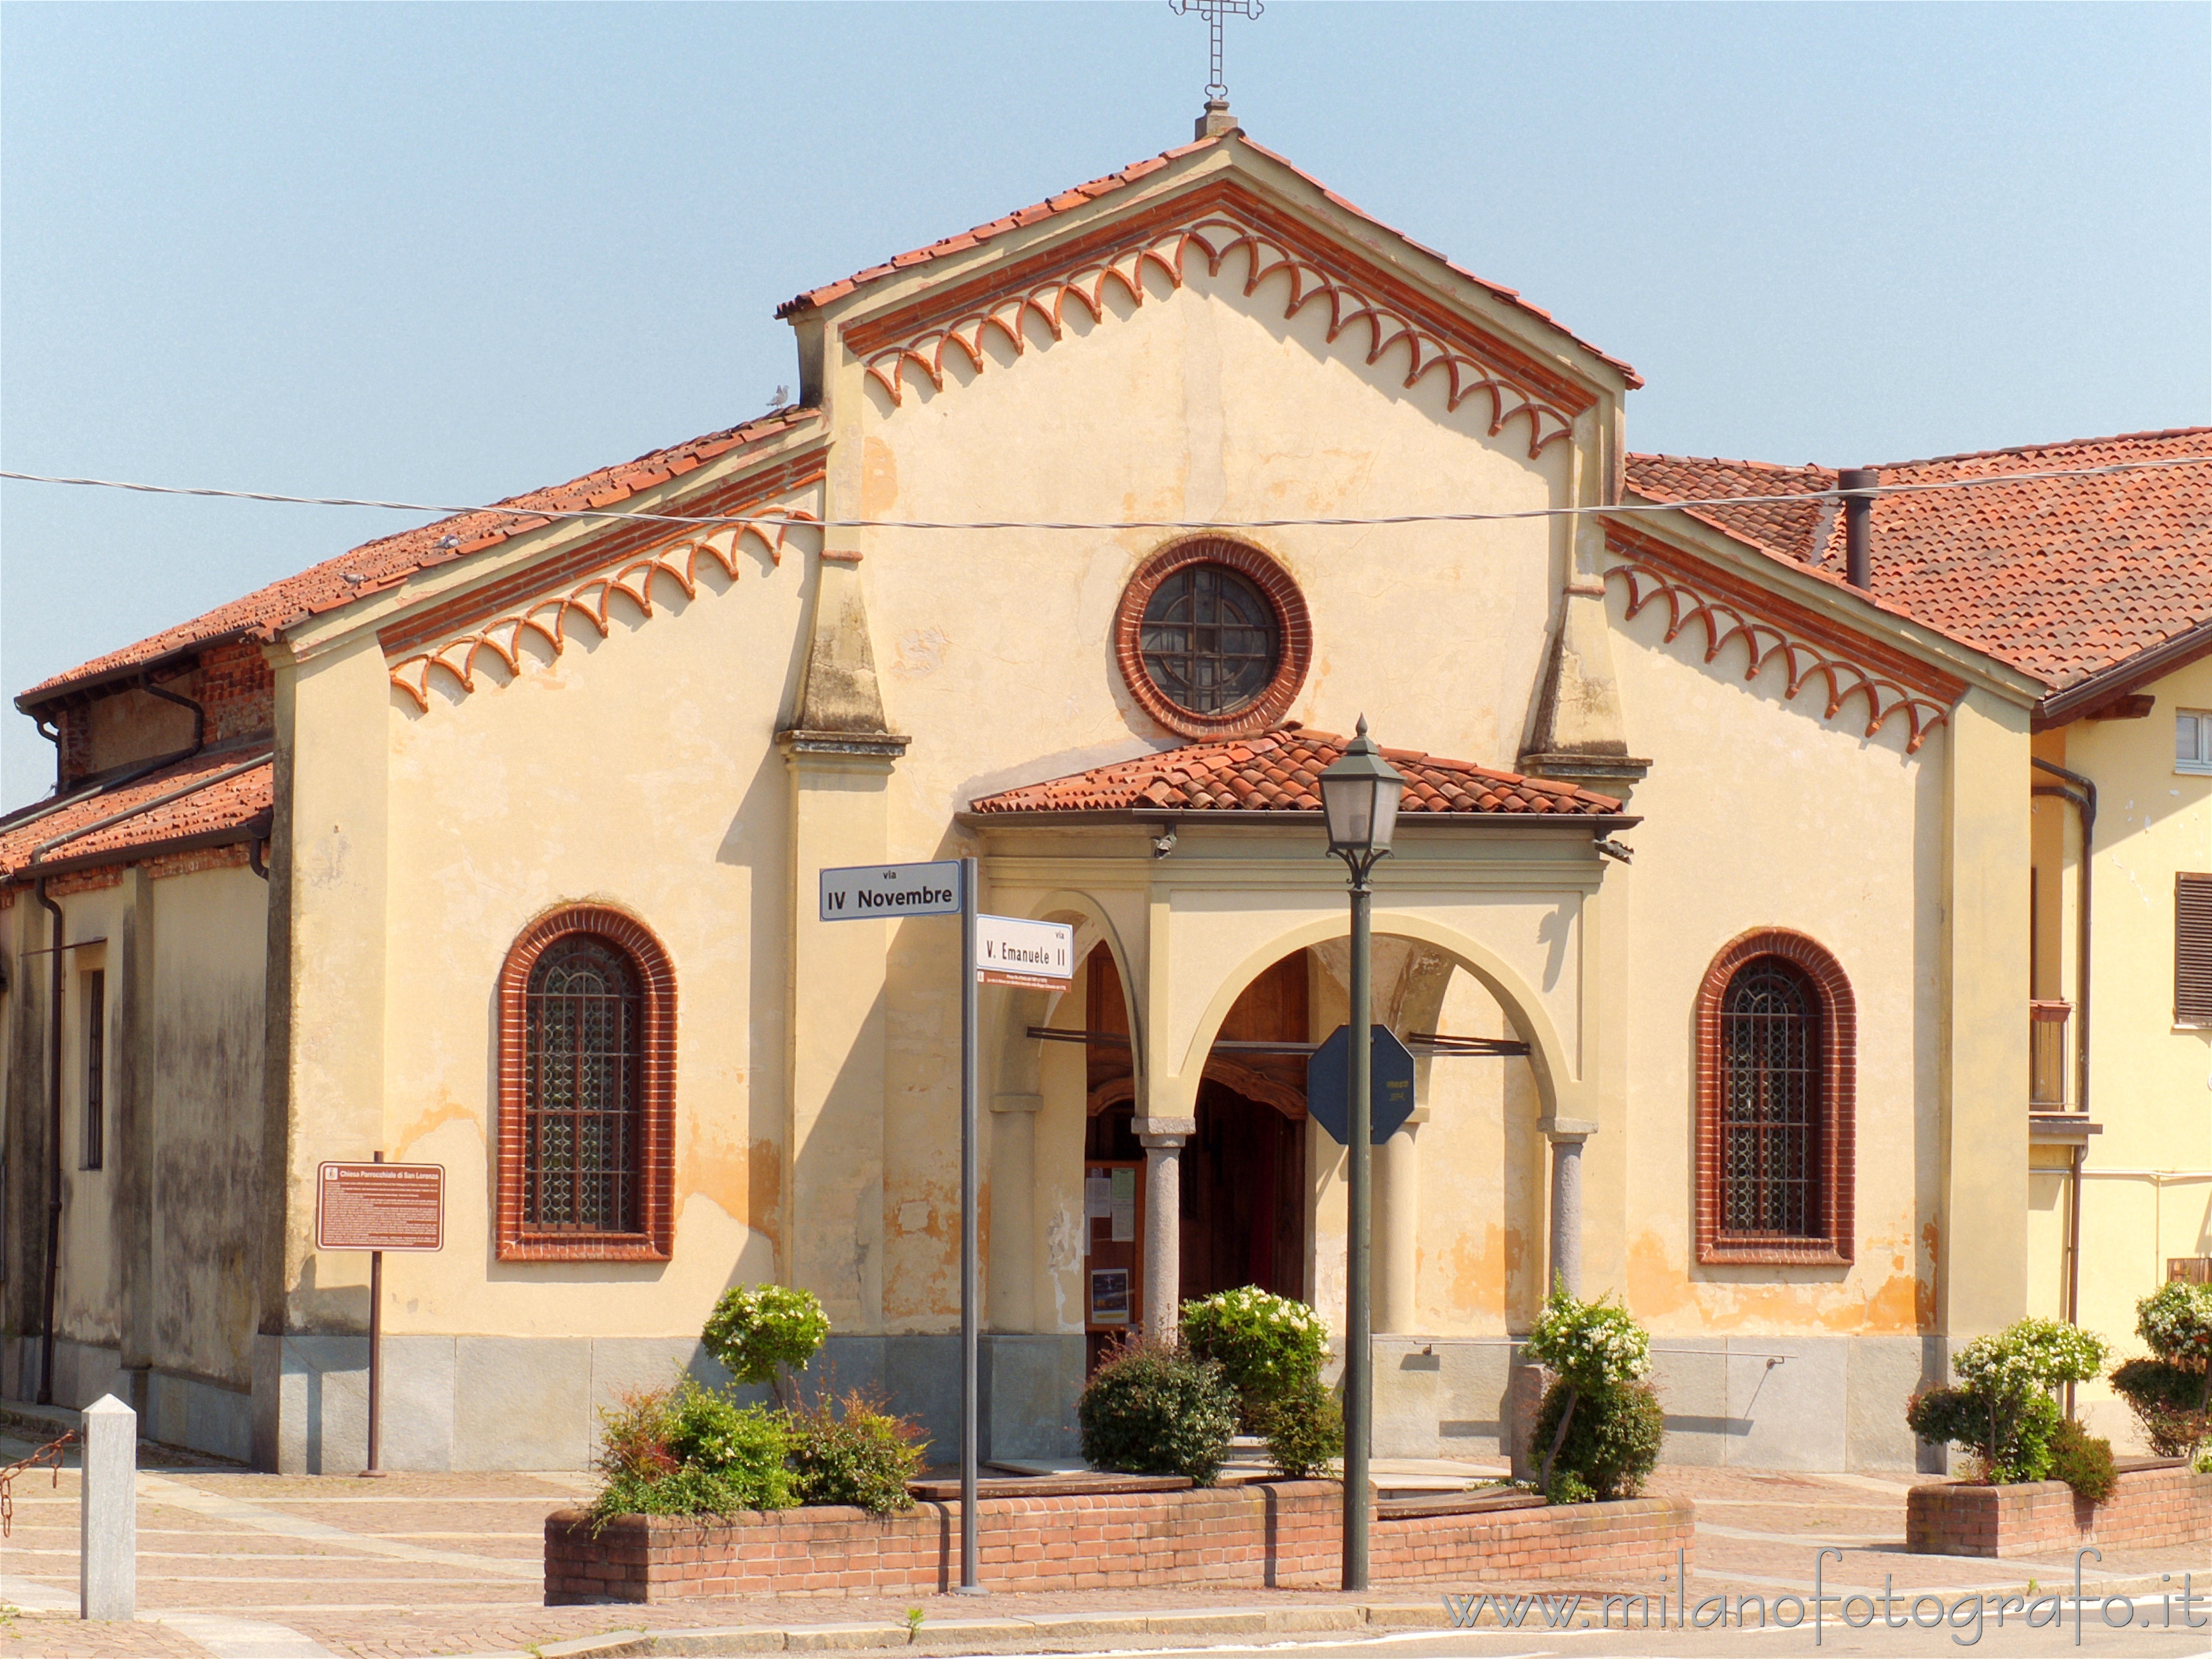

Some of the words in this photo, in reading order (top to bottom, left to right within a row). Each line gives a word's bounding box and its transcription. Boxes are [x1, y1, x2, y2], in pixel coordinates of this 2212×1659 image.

[883, 871, 897, 879] via
[828, 891, 846, 910] IV
[858, 886, 952, 909] Novembre
[1055, 930, 1065, 940] via
[987, 940, 997, 959] V.
[1002, 942, 1050, 964] Emanuele
[1057, 947, 1065, 967] II
[361, 1170, 397, 1178] Parrocchiale
